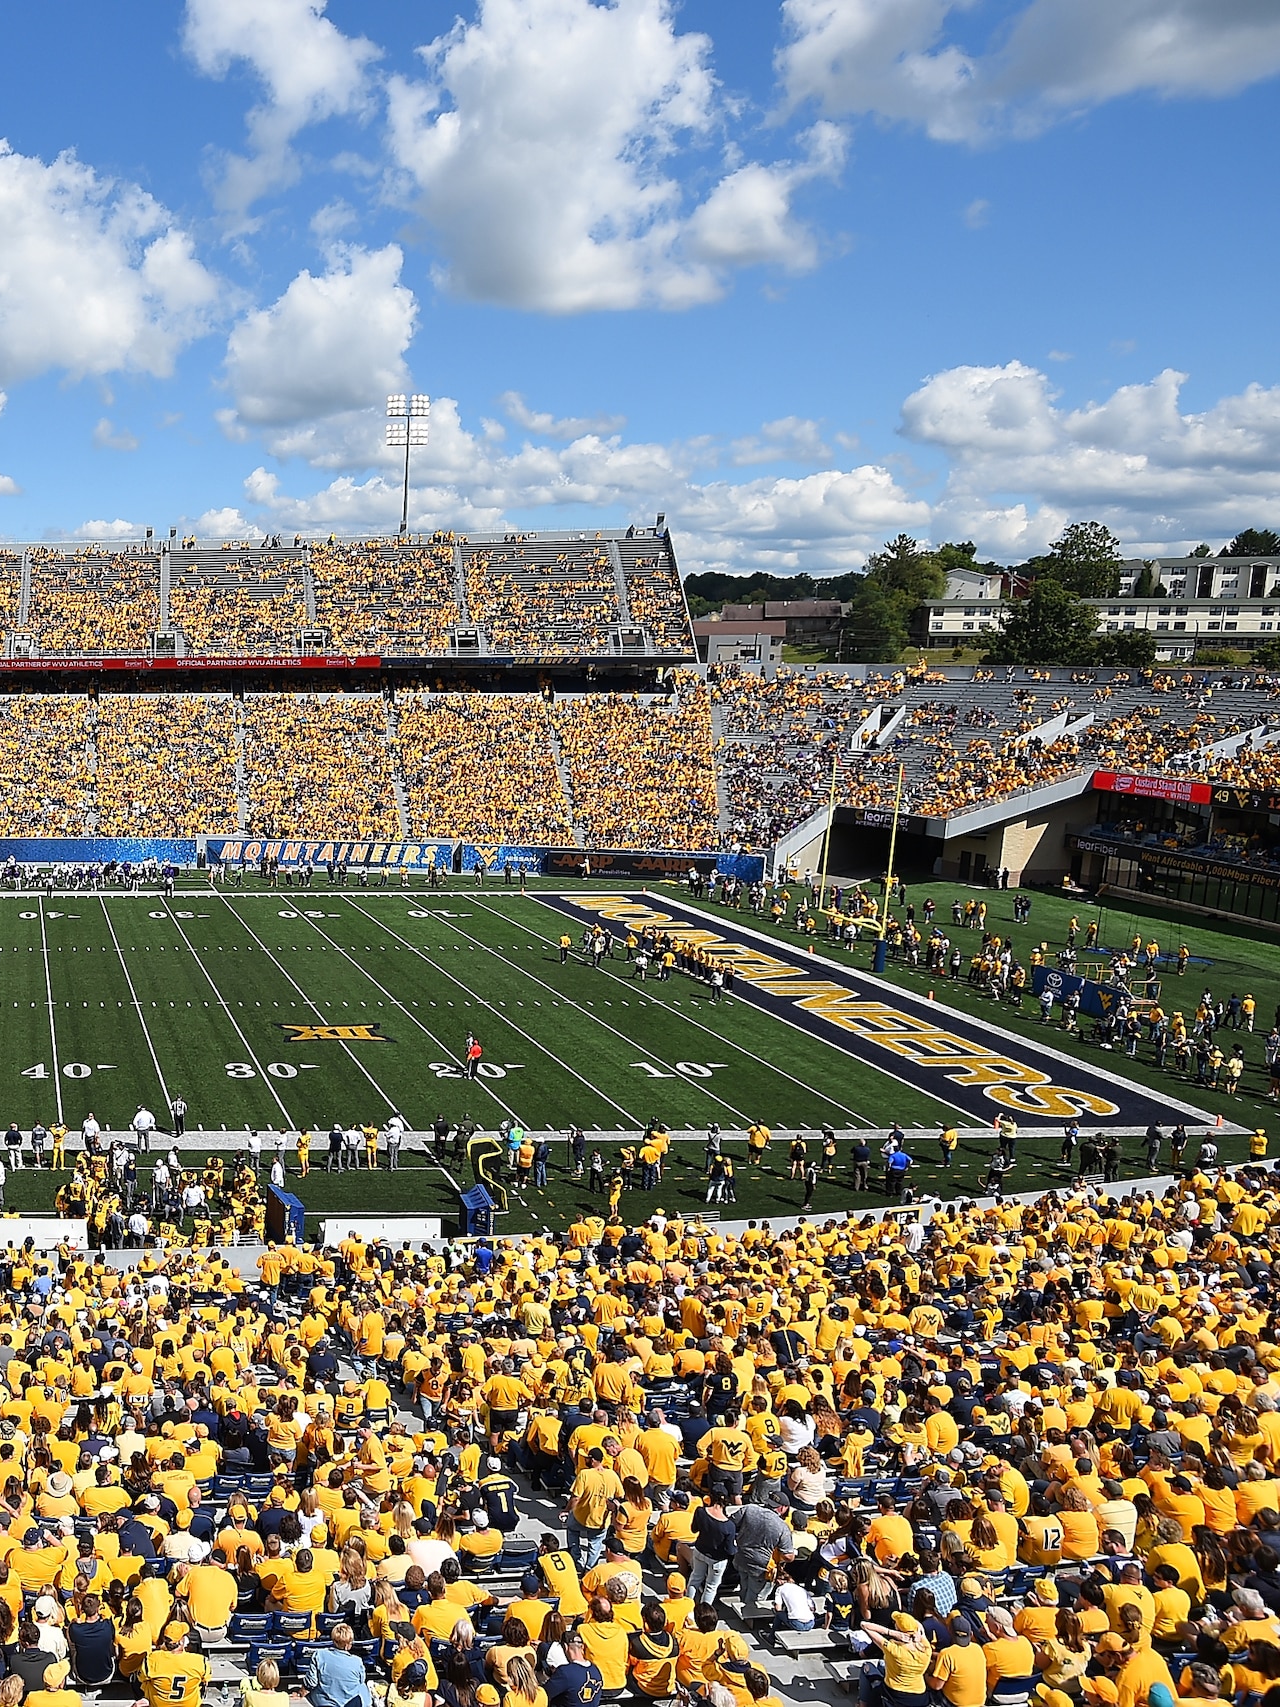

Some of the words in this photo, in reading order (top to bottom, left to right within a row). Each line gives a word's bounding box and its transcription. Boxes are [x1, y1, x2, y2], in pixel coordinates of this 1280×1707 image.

[1135, 777, 1158, 788] Custard
[1158, 779, 1176, 791] Stand
[1214, 790, 1230, 803] 49
[220, 841, 439, 864] MOUNTAINEERS
[505, 855, 536, 863] NISSAN
[553, 854, 616, 867] AARP
[632, 857, 697, 872] AARP
[1141, 851, 1160, 863] Want
[1162, 855, 1204, 871] Affordable
[1205, 864, 1250, 882] 1,000Mbps
[1251, 873, 1274, 887] Fiber
[559, 896, 1121, 1119] MOUNTAINEERS
[20, 1062, 93, 1080] 40
[224, 1062, 299, 1079] 30
[427, 1062, 506, 1079] 20
[631, 1060, 714, 1079] 10
[756, 1302, 764, 1312] 8
[430, 1380, 438, 1390] 8
[722, 1377, 731, 1391] 8
[346, 1403, 354, 1413] 8
[764, 1419, 776, 1434] 8
[773, 1457, 785, 1472] 15
[497, 1491, 509, 1513] 1
[1042, 1527, 1061, 1551] 12
[551, 1553, 566, 1571] 8
[169, 1675, 188, 1700] 5
